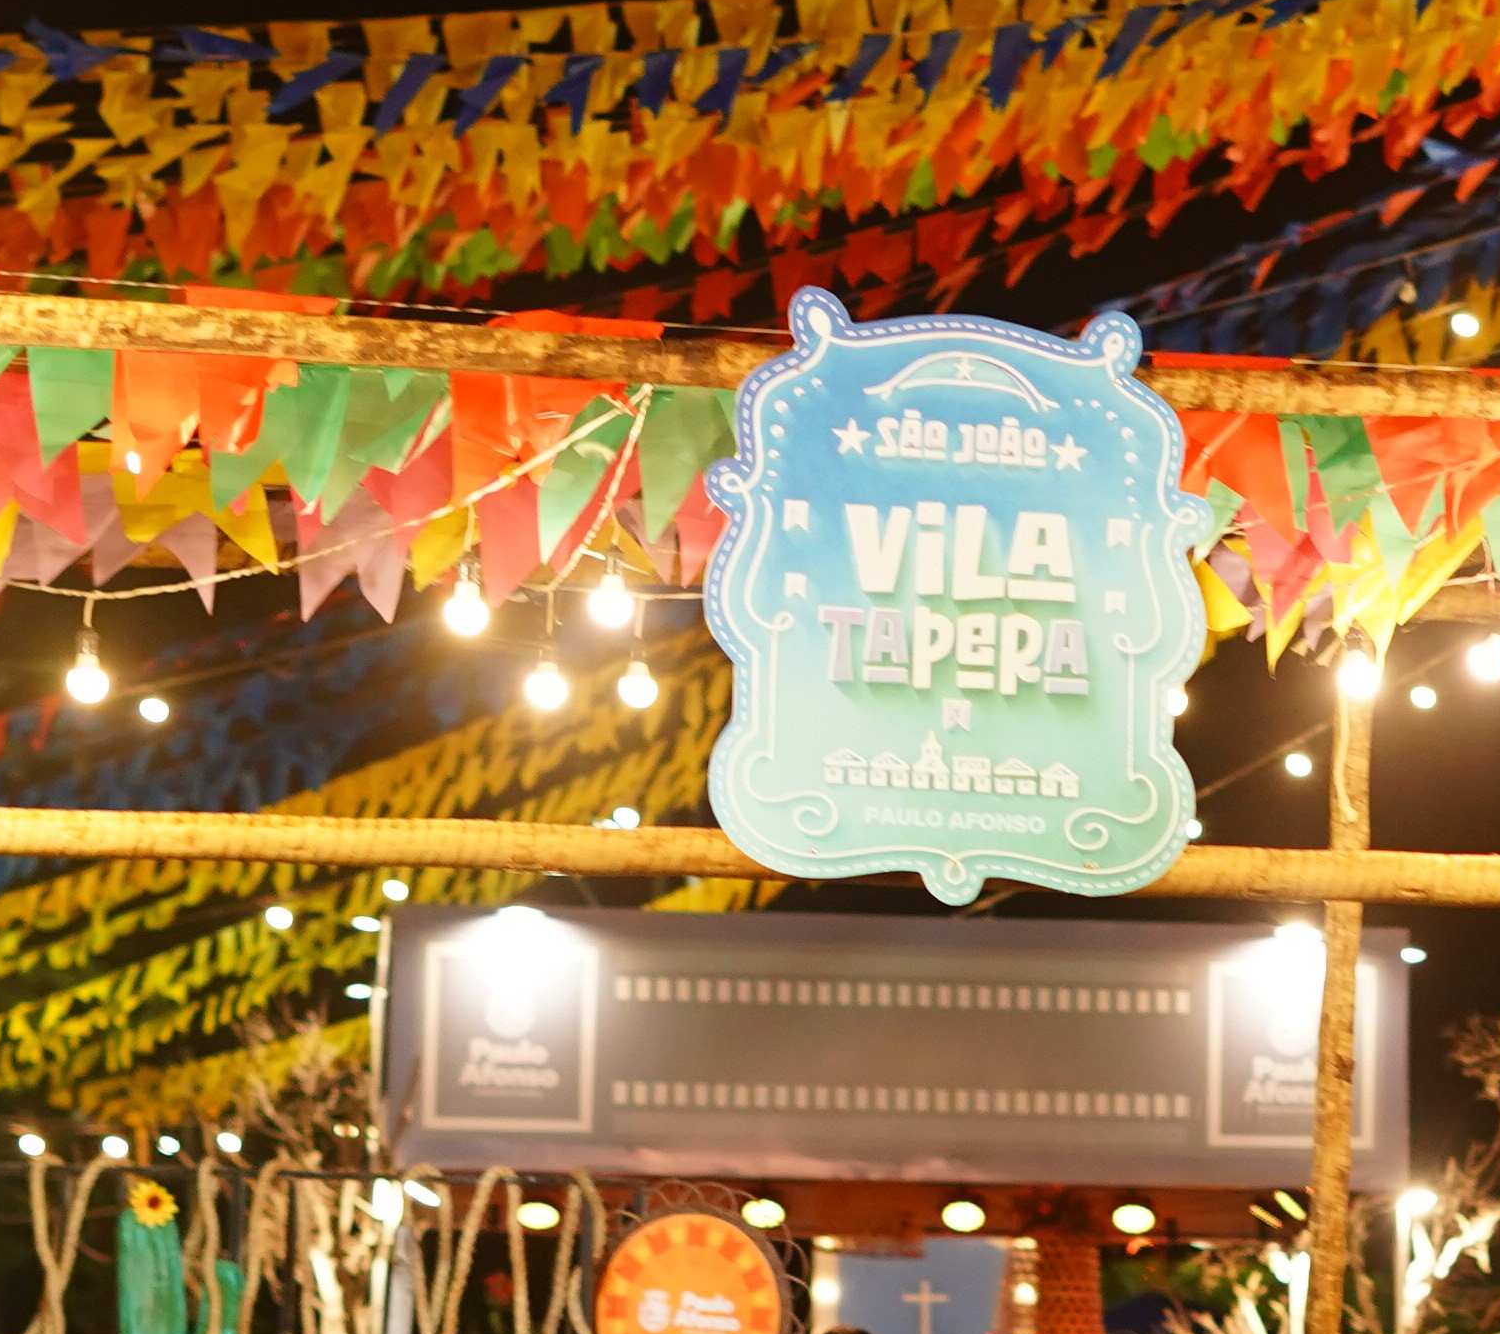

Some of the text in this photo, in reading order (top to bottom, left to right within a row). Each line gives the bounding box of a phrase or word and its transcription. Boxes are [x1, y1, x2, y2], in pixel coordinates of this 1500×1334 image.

[864, 806, 1047, 834] PAULO AFONSO
[1253, 1056, 1317, 1082] Paul
